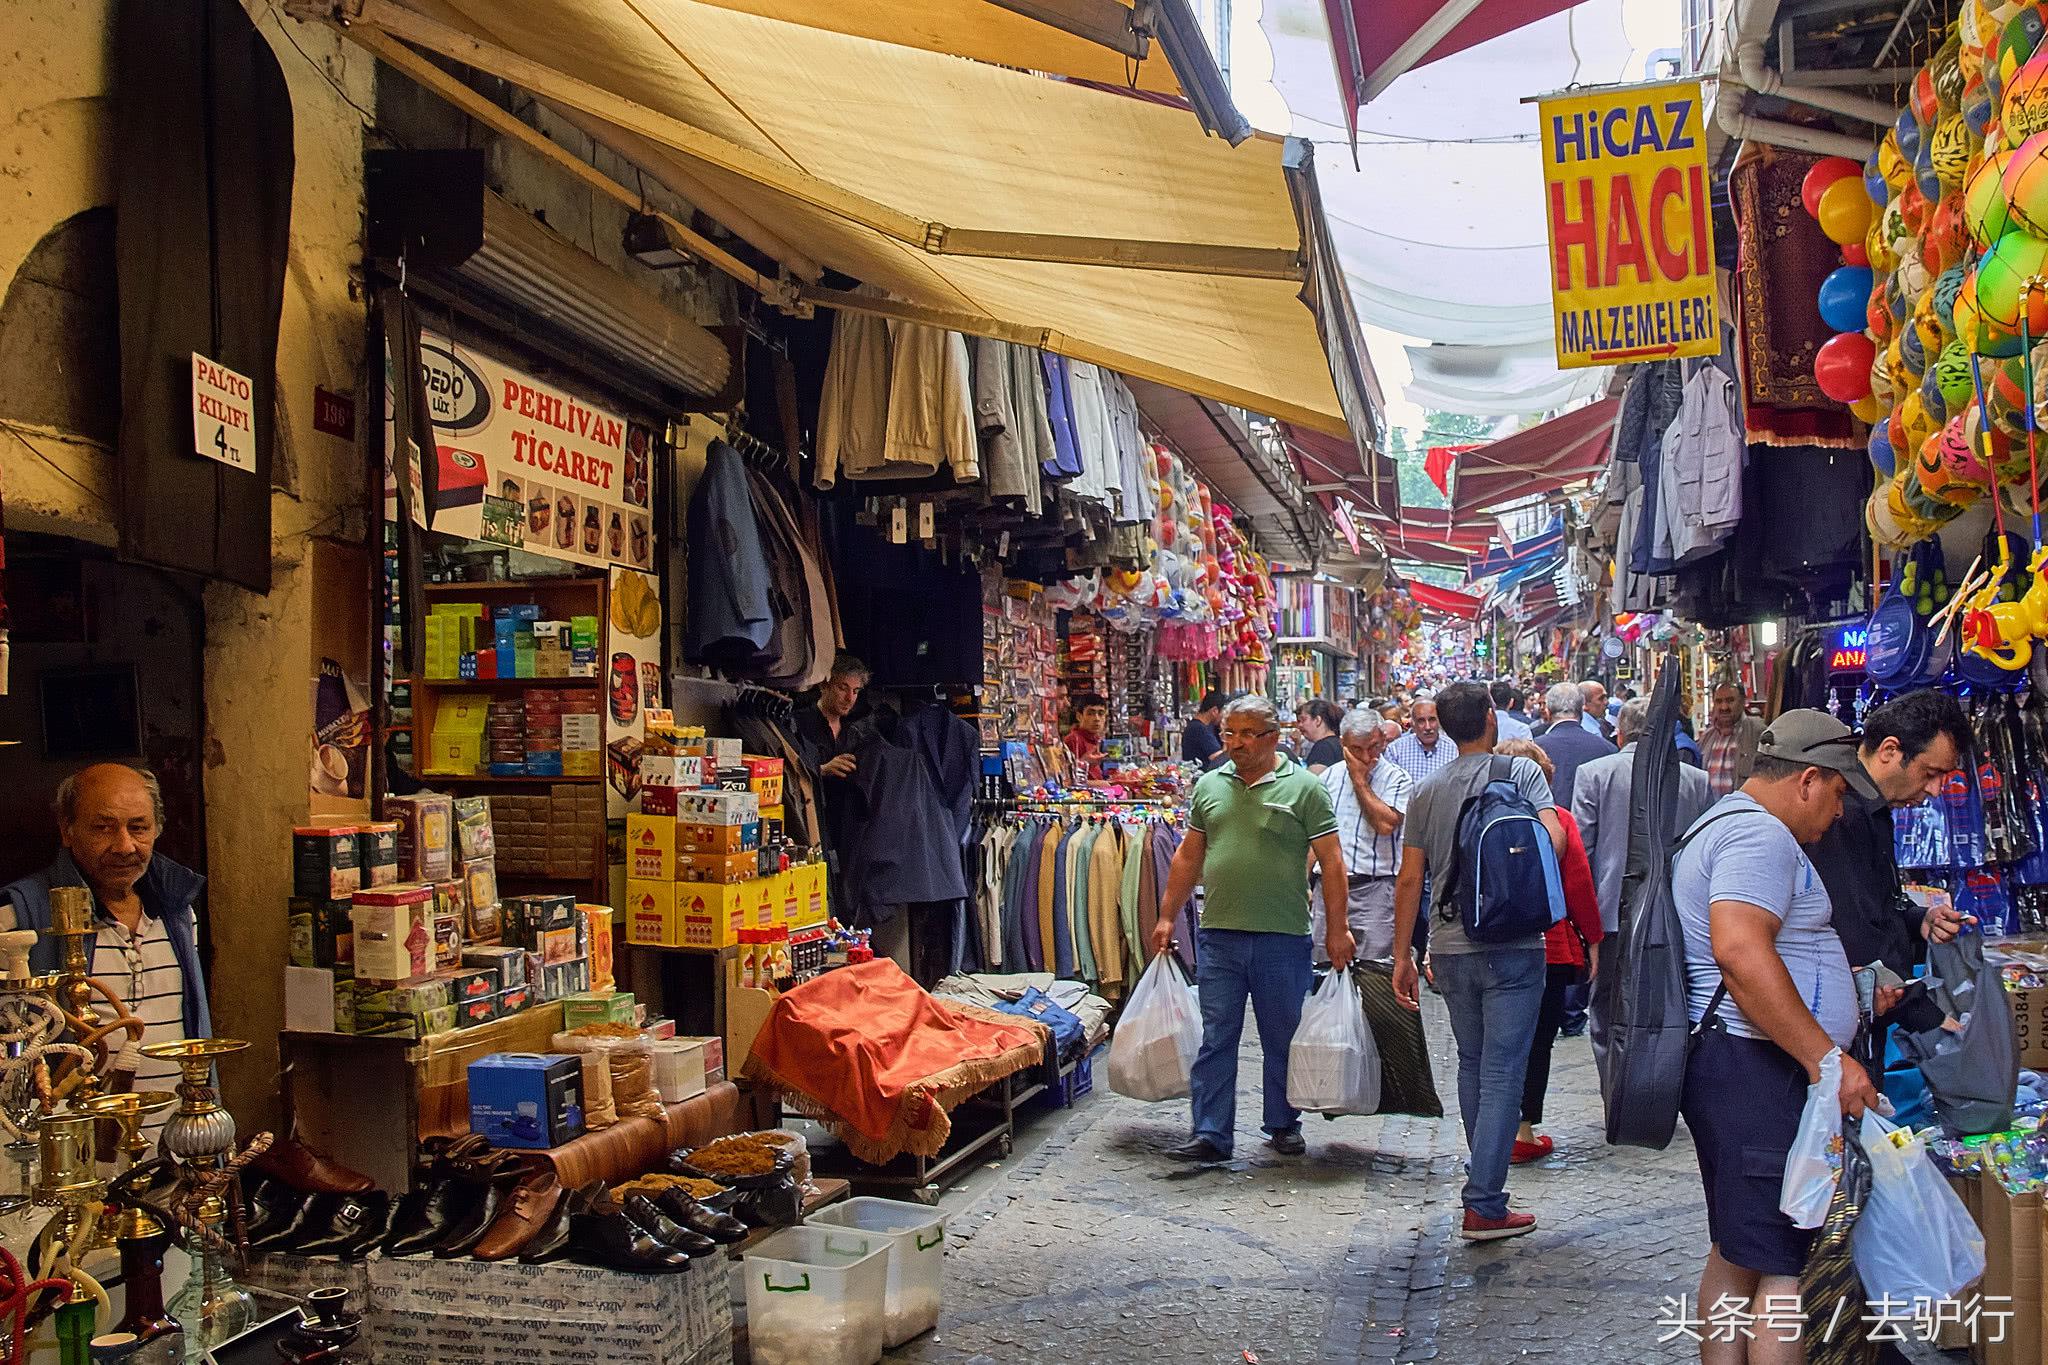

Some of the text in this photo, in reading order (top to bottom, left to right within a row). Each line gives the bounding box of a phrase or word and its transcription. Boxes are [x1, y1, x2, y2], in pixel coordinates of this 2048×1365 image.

[1550, 165, 1709, 291] HACI
[197, 359, 249, 400] PALTO
[199, 393, 249, 432] KILIFI
[503, 378, 623, 449] PEHLİVAN
[214, 425, 241, 462] 4 TL
[512, 429, 613, 489] TİCARET
